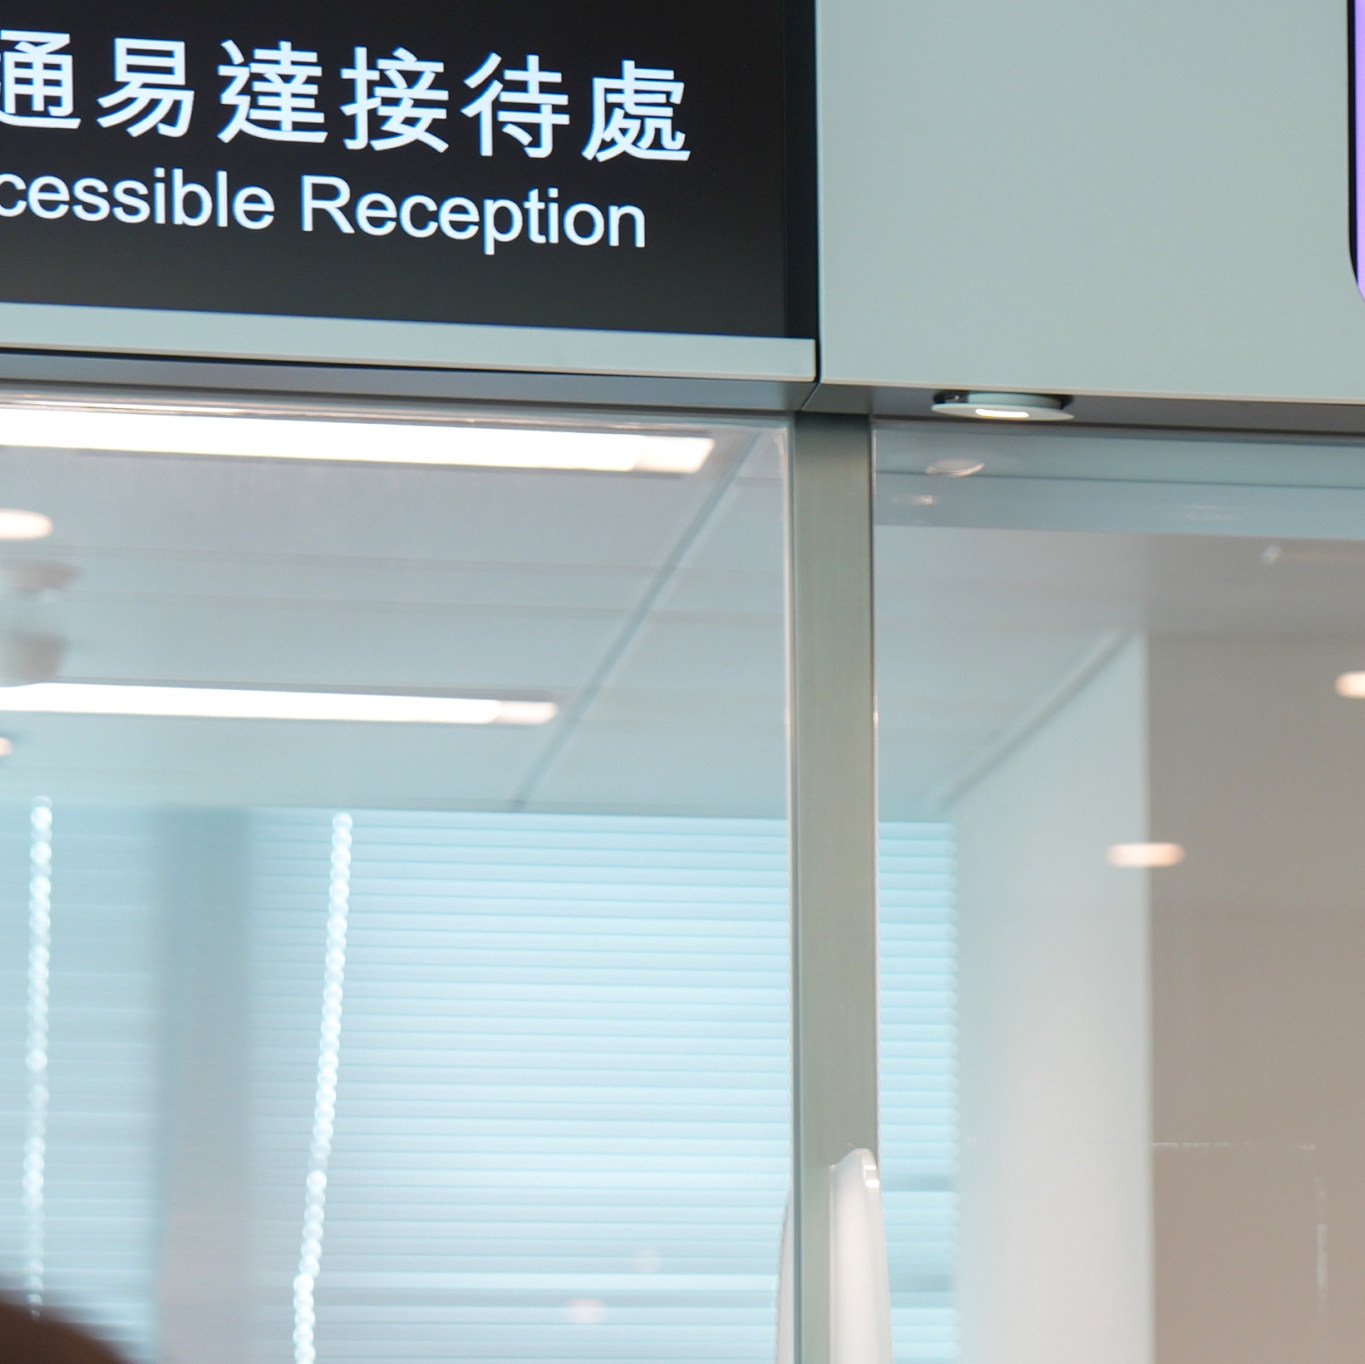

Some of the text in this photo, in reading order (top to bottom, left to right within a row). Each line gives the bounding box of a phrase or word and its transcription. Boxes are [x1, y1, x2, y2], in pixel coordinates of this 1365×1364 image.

[0, 29, 691, 163] 通易達接待處
[0, 166, 646, 256] cessible Reception
